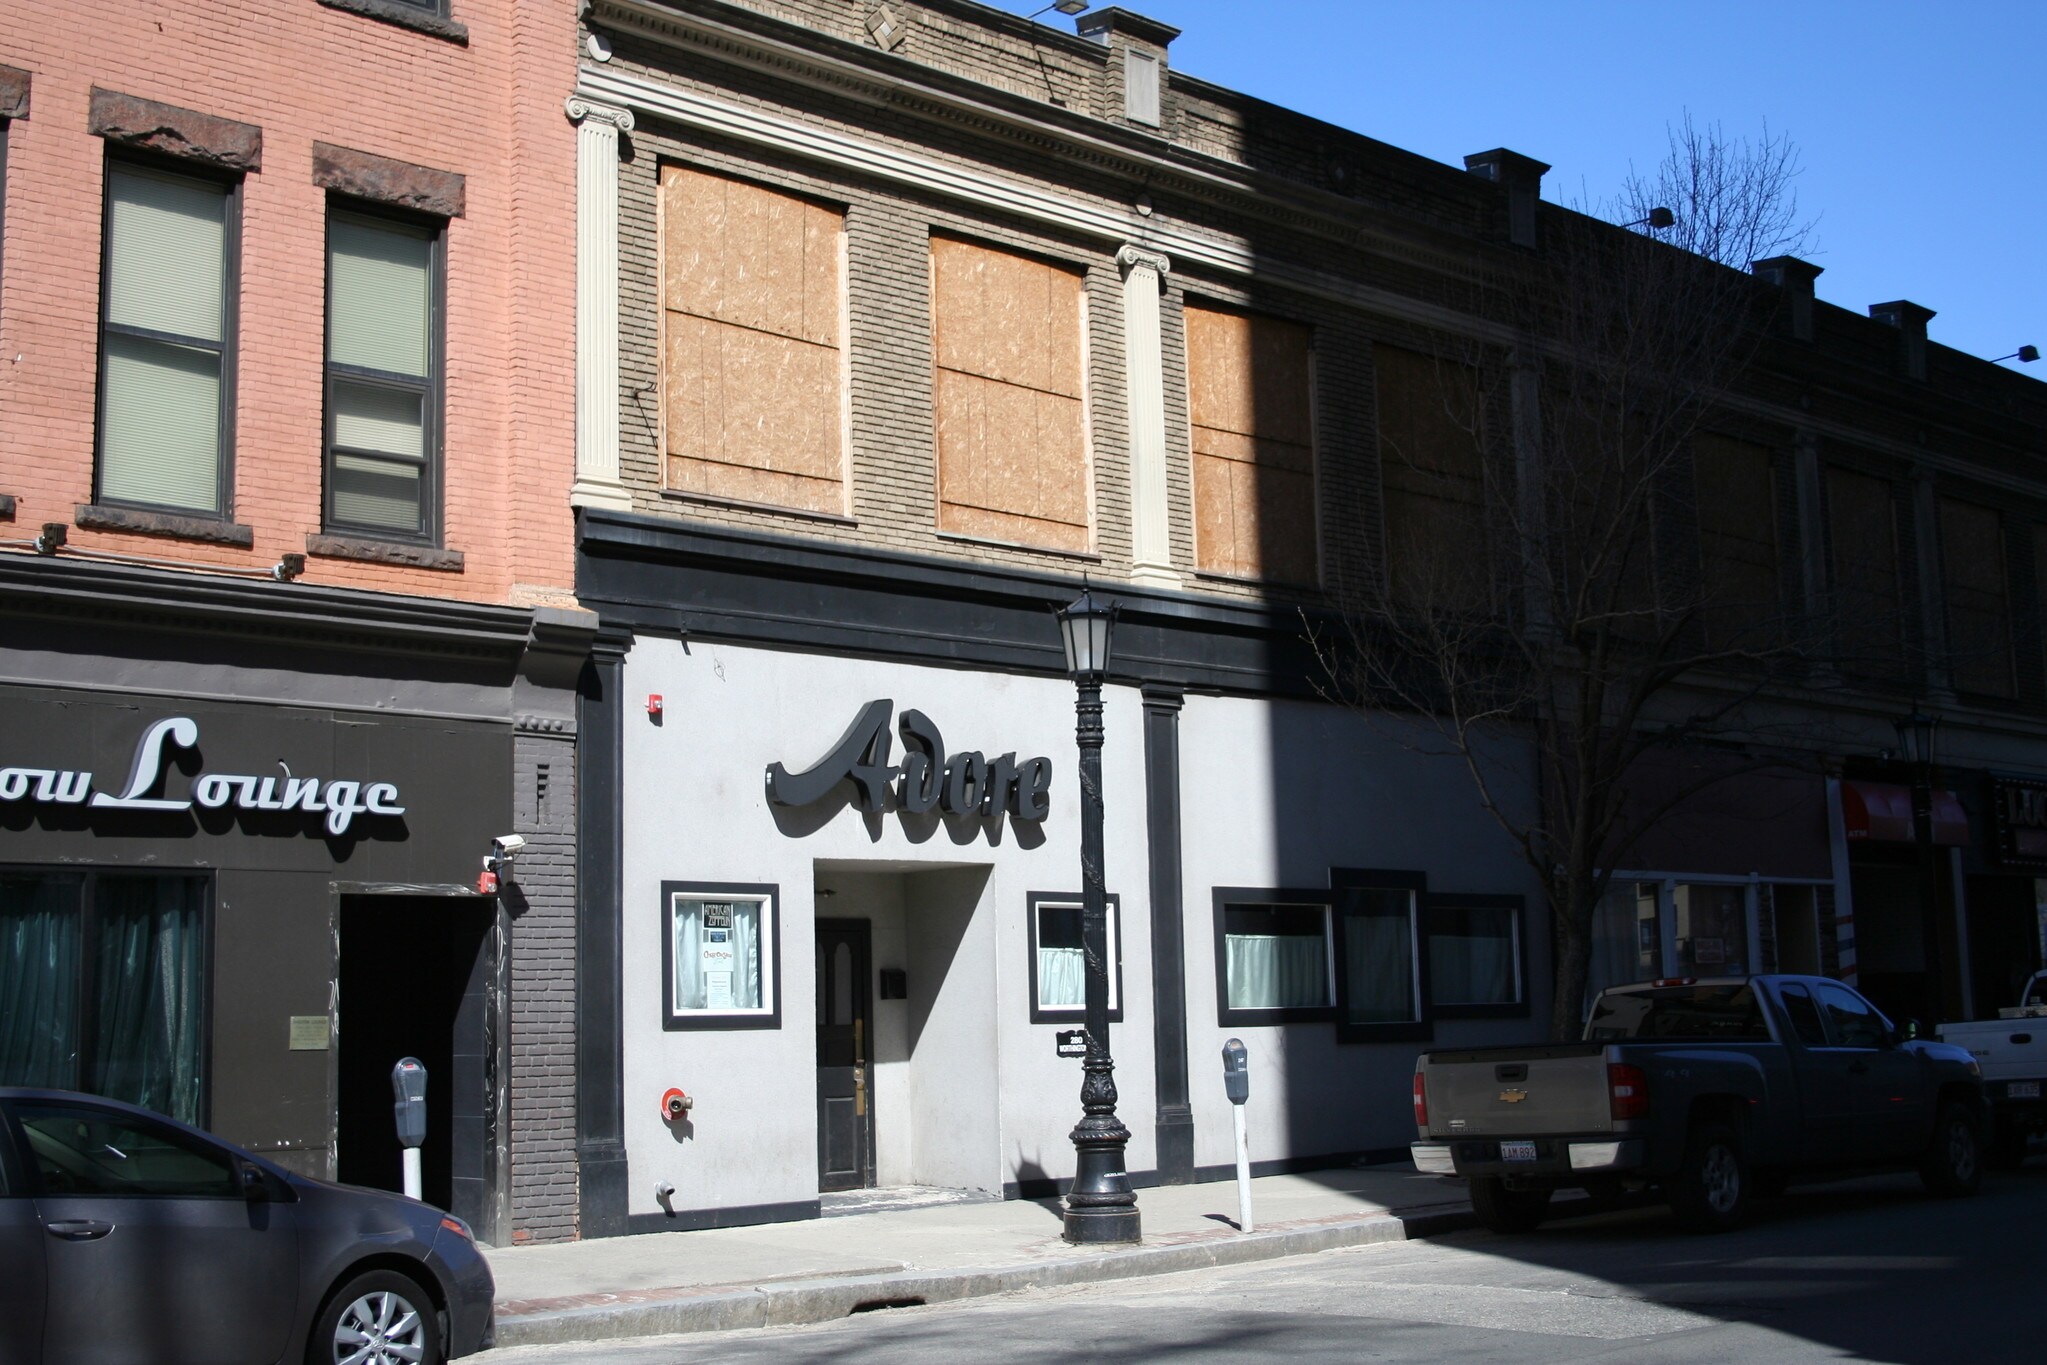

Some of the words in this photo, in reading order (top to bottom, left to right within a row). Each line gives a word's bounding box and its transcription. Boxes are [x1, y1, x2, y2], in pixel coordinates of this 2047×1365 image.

[765, 698, 1052, 822] Adore
[89, 717, 406, 835] Lounge
[1847, 829, 1868, 838] ATM
[1070, 1036, 1083, 1045] 280
[1519, 1146, 1536, 1159] 892
